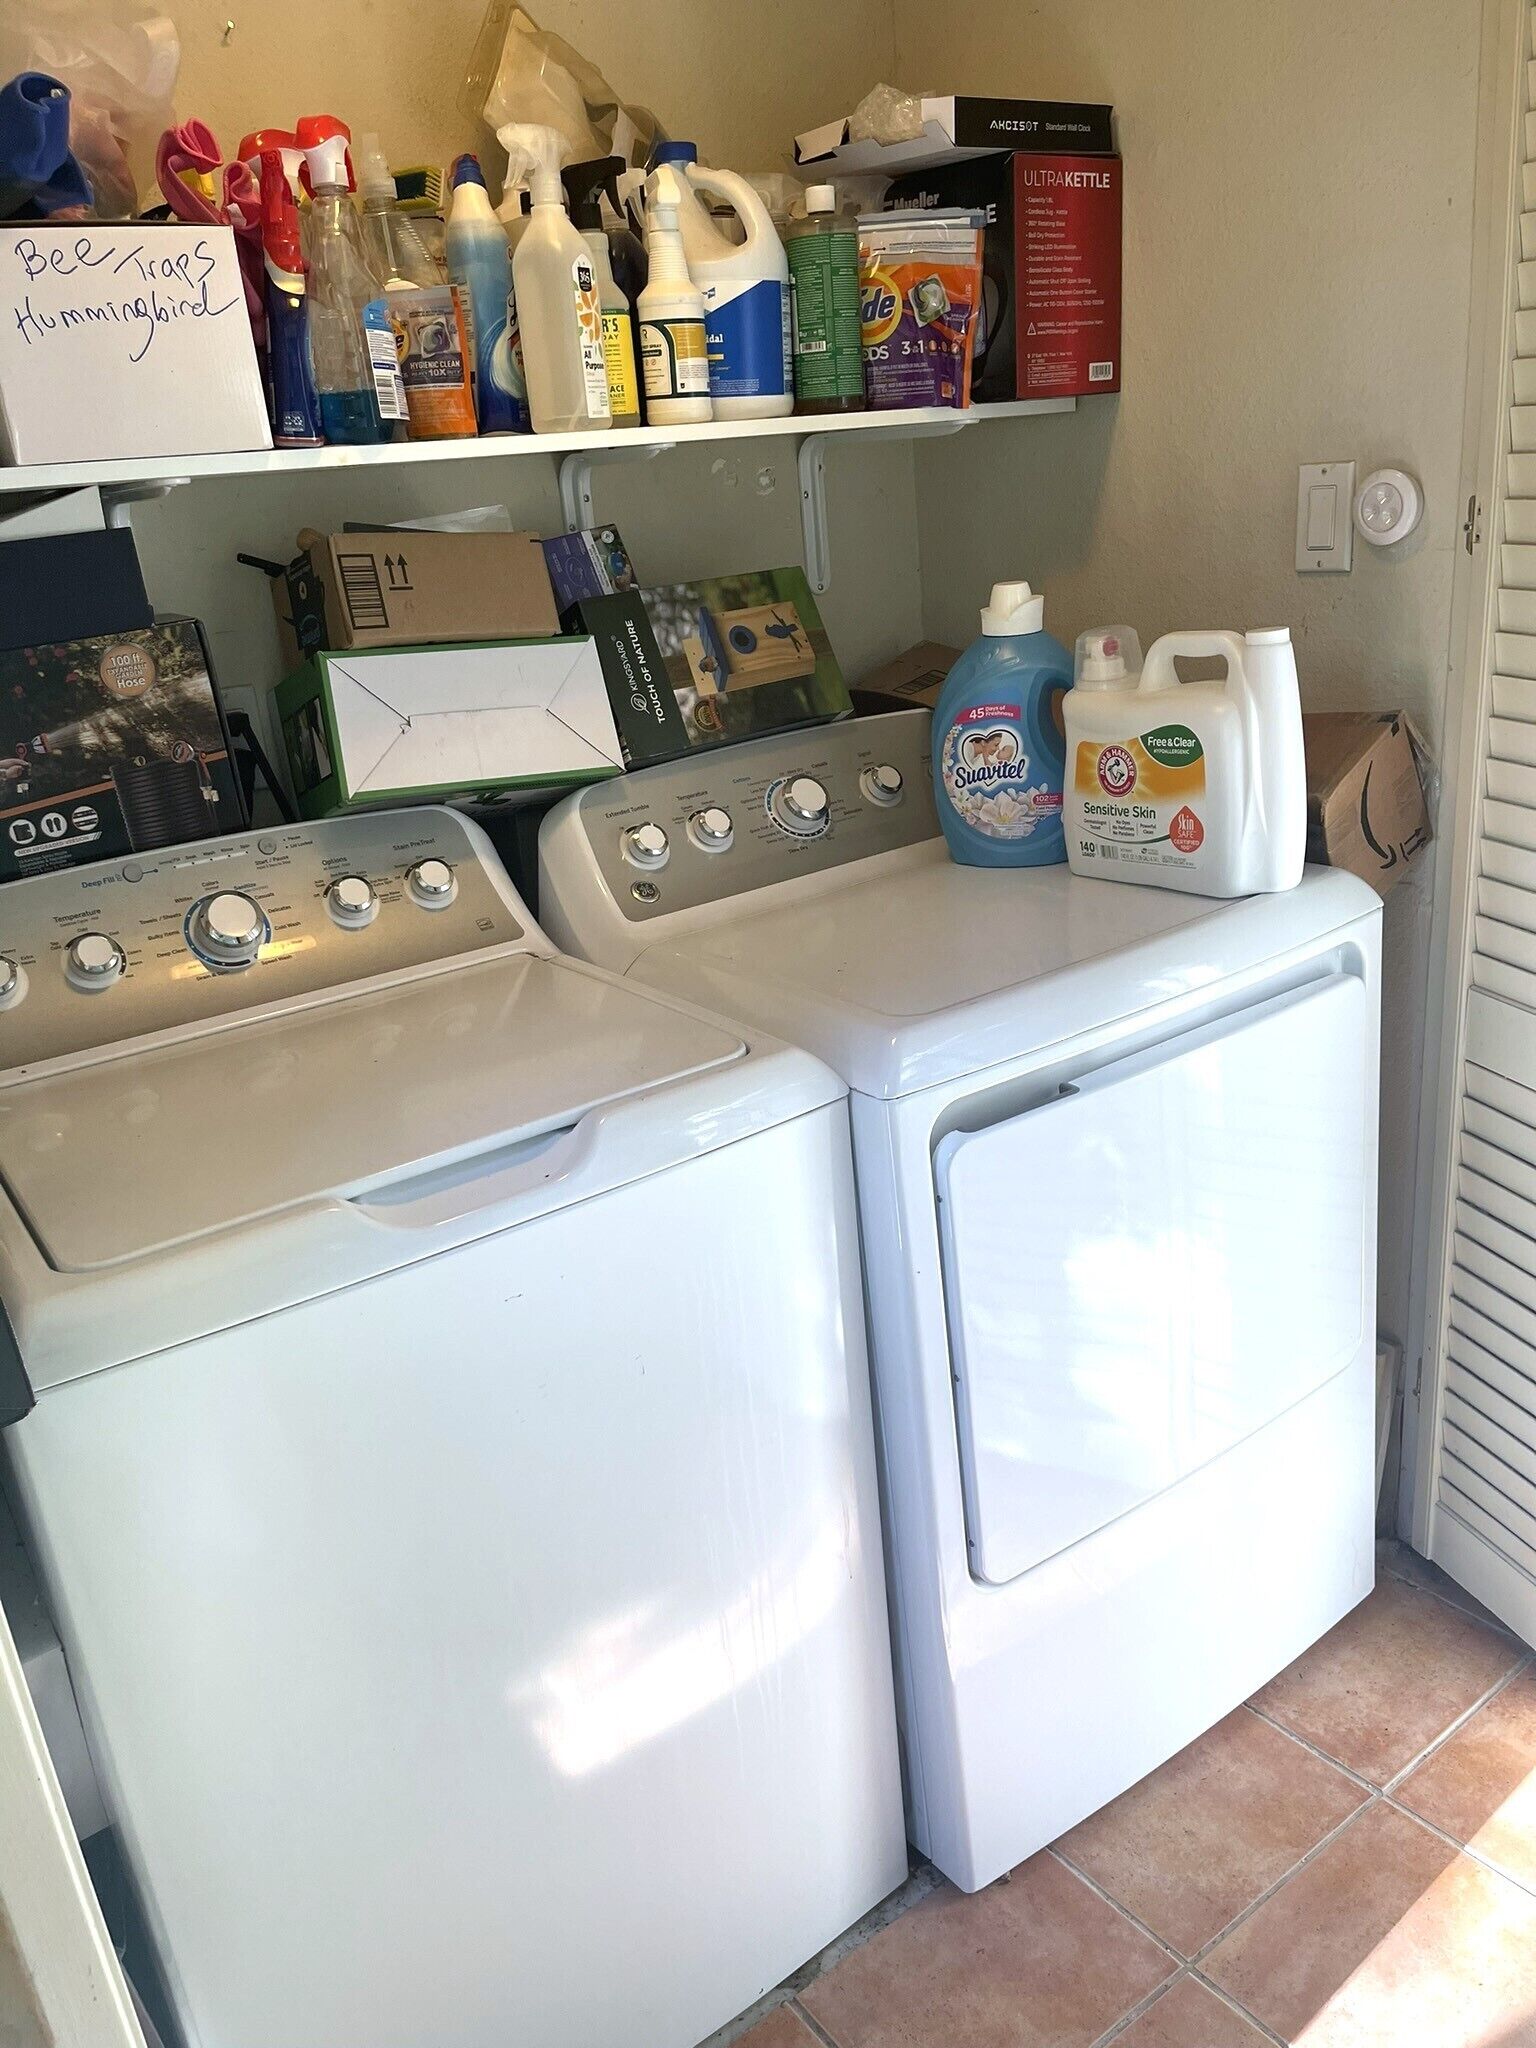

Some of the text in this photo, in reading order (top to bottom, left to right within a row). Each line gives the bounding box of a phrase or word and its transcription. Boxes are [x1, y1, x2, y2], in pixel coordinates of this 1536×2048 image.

[989, 119, 1039, 132] AKCISOT
[1024, 170, 1111, 188] ULTRAKETTLE
[894, 191, 940, 209] Mueller
[15, 238, 216, 289] Bee Traps
[14, 280, 240, 362] Hummingbird
[584, 350, 592, 359] All
[410, 360, 460, 370] HYGIENIC CLEAN
[428, 368, 447, 377] 10X
[110, 653, 144, 668] 100 ft.
[615, 640, 639, 692] KINGSYARD
[625, 619, 666, 724] TOUCH OF NATURE
[117, 678, 146, 688] Hose
[968, 707, 985, 719] 45
[1147, 736, 1196, 747] Free&Clear
[1111, 748, 1135, 777] HAMMER
[955, 758, 1025, 788] Suavitel
[676, 790, 708, 801] Temperature
[605, 804, 650, 819] Extended Tumble
[1083, 801, 1156, 819] Sensitive Skin
[1178, 813, 1195, 831] Skin
[392, 842, 410, 851] Stain
[1079, 841, 1095, 852] 140
[321, 856, 348, 866] Options
[81, 876, 115, 889] Deep Fill
[201, 879, 219, 887] Colors
[52, 908, 102, 923] Temperature
[267, 905, 292, 914] Delicates
[274, 923, 287, 931] Cold
[157, 947, 188, 959] Deep Clean
